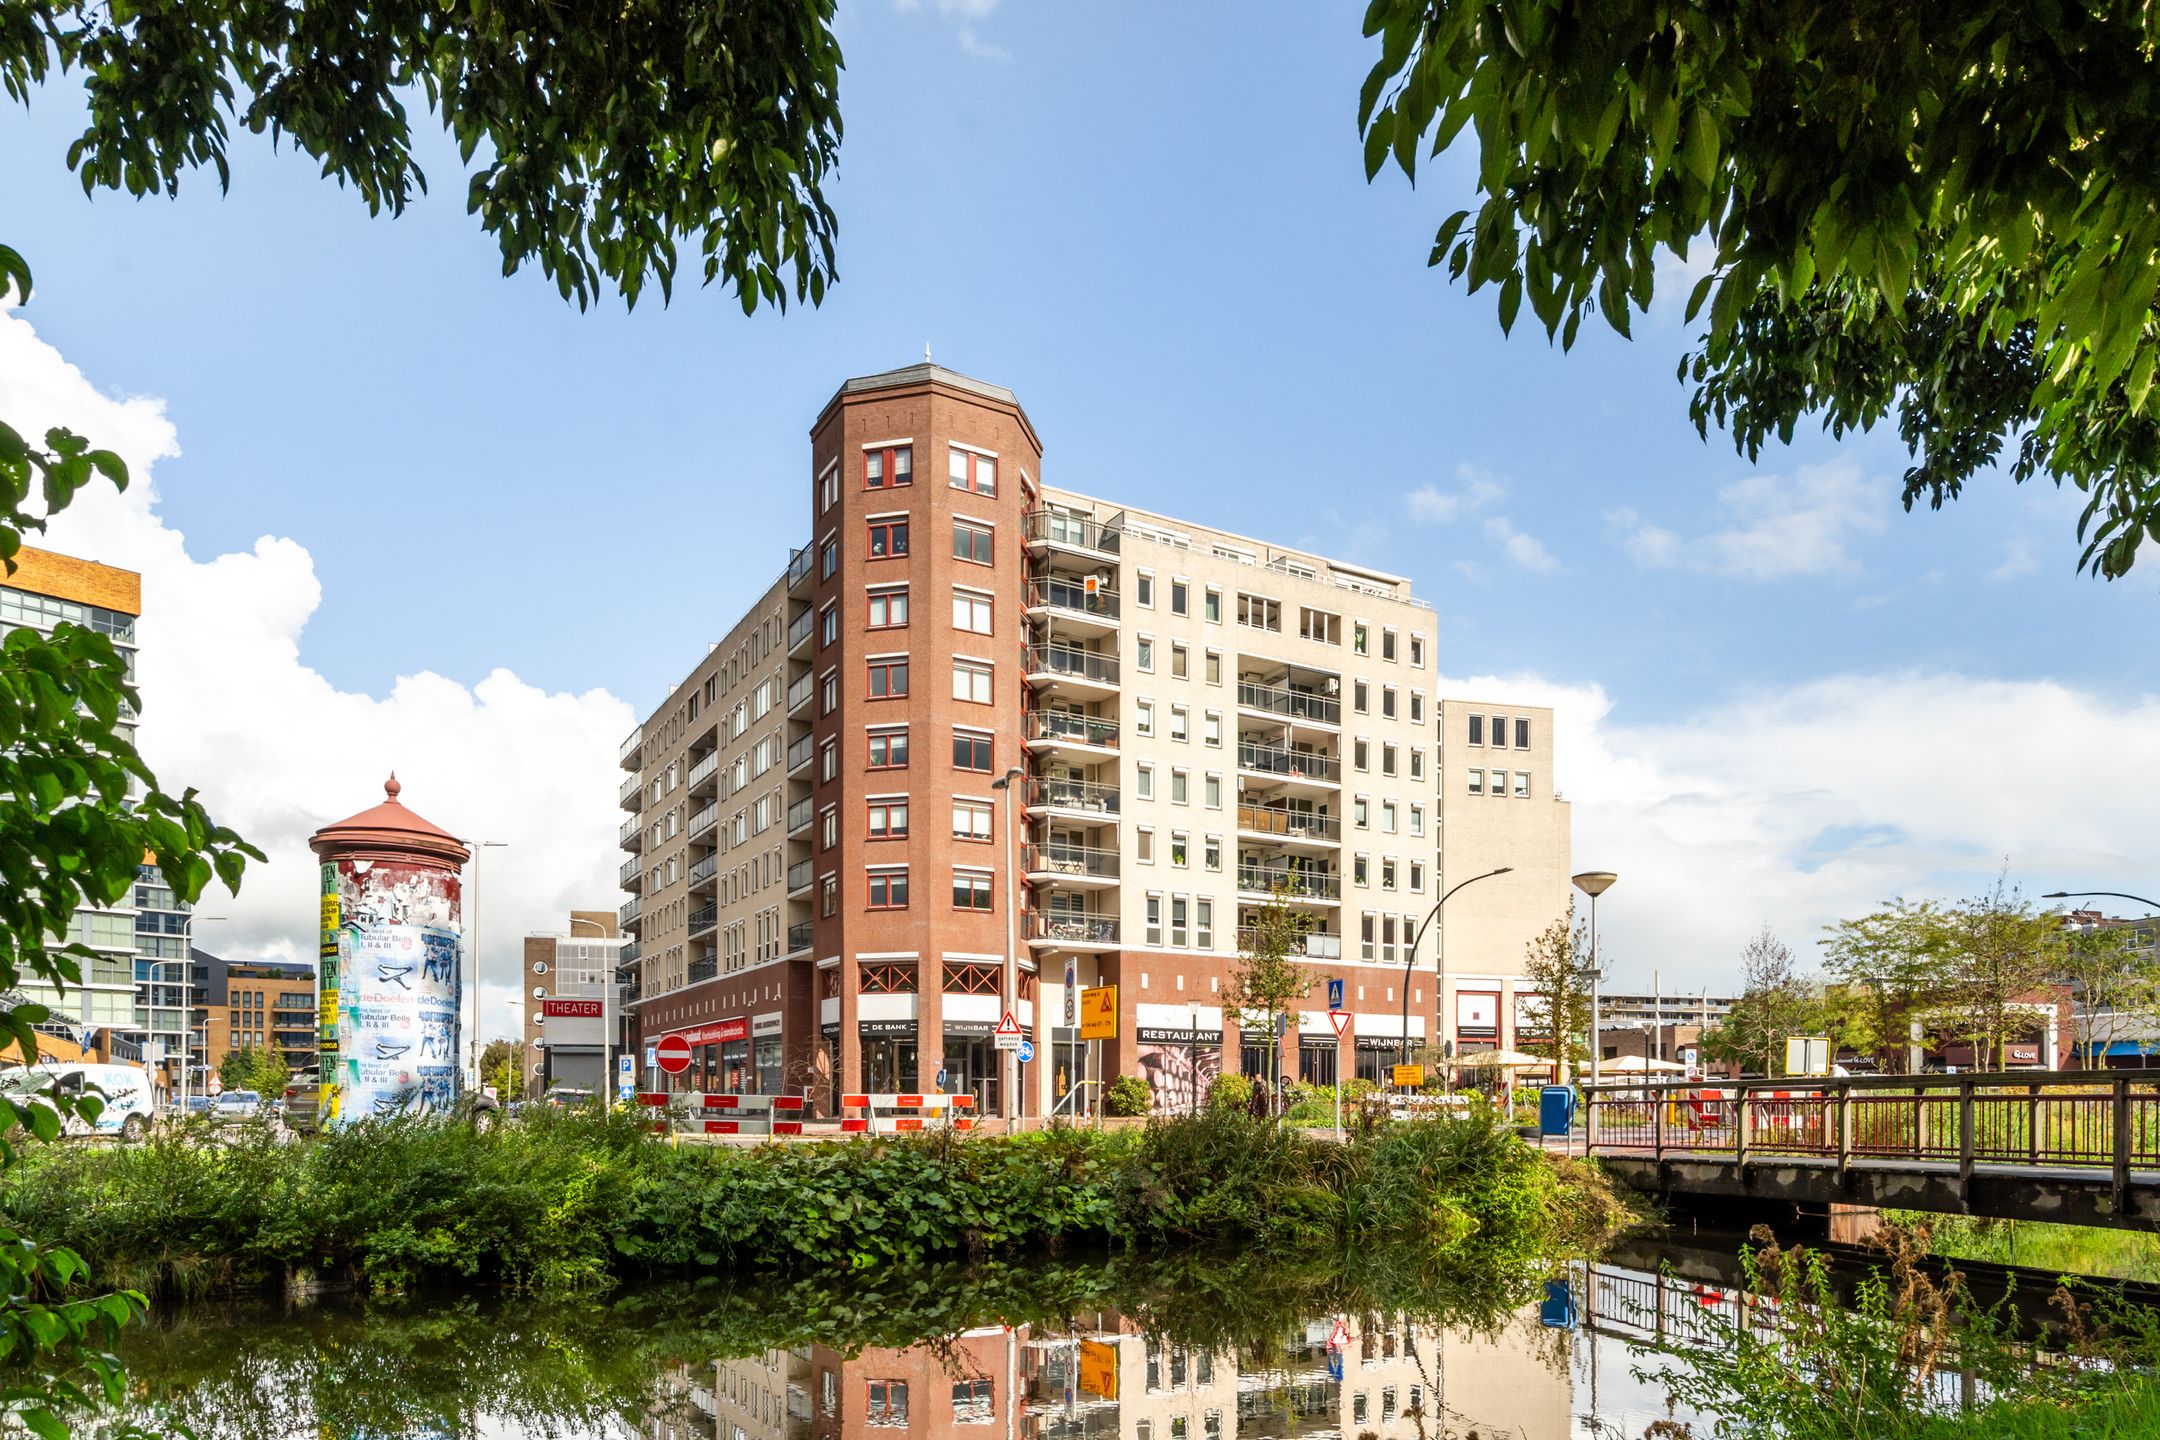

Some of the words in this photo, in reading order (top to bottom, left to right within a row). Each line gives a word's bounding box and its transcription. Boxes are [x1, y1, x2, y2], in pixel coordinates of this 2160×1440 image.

[360, 934, 389, 942] Tubular
[549, 1002, 598, 1014] THEATER
[359, 1013, 388, 1021] Tubular
[390, 1014, 410, 1022] Bells
[623, 1060, 630, 1071] P
[389, 1069, 409, 1077] Bells
[104, 1072, 133, 1086] KOK
